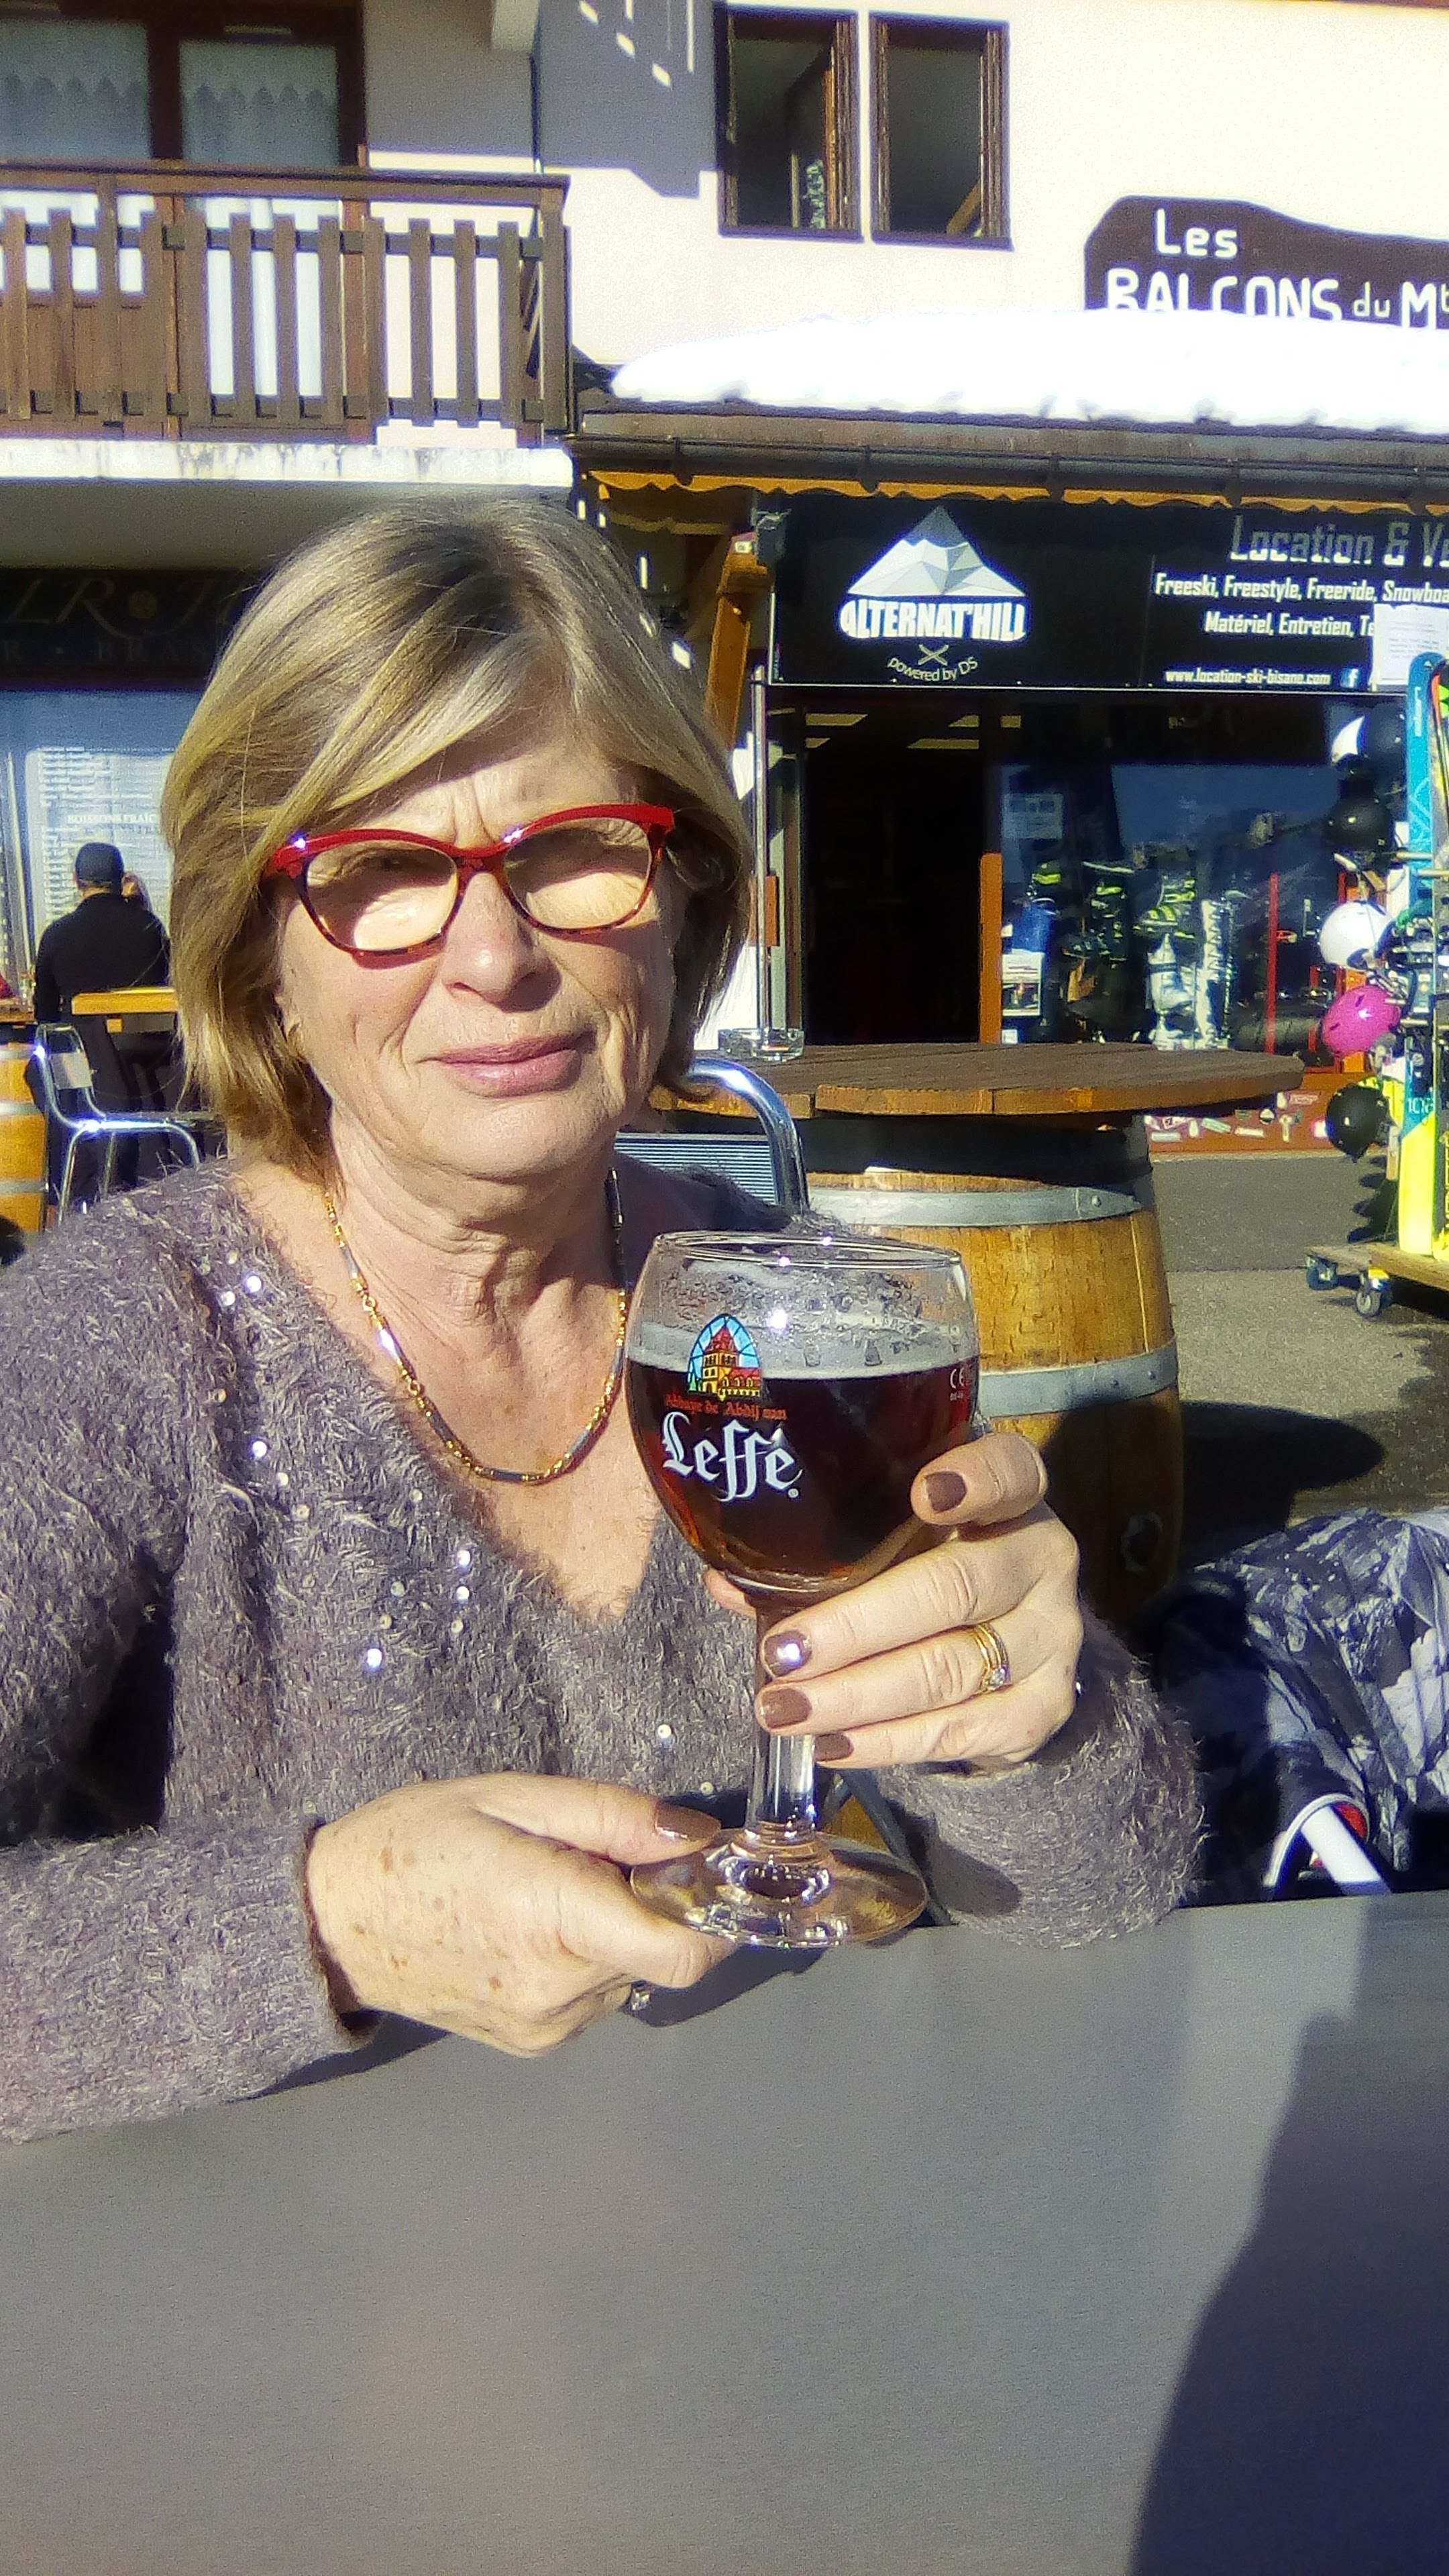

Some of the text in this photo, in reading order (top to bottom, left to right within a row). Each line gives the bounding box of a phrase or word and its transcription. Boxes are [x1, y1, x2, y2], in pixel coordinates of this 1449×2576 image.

[1155, 208, 1238, 259] Les
[1107, 268, 1342, 322] BALCONS
[1352, 281, 1391, 318] du
[1230, 515, 1375, 565] Location
[1383, 521, 1409, 566] &
[1155, 572, 1219, 598] Freeski,
[1224, 575, 1302, 603] Freestyle,
[1307, 578, 1377, 602] Freeride,
[840, 599, 1027, 642] ALTERNAT'HILL
[1205, 610, 1274, 636] Matériel,
[1279, 612, 1354, 637] Entretien,
[887, 656, 978, 682] powered by DS
[662, 1411, 802, 1503] Leffe
